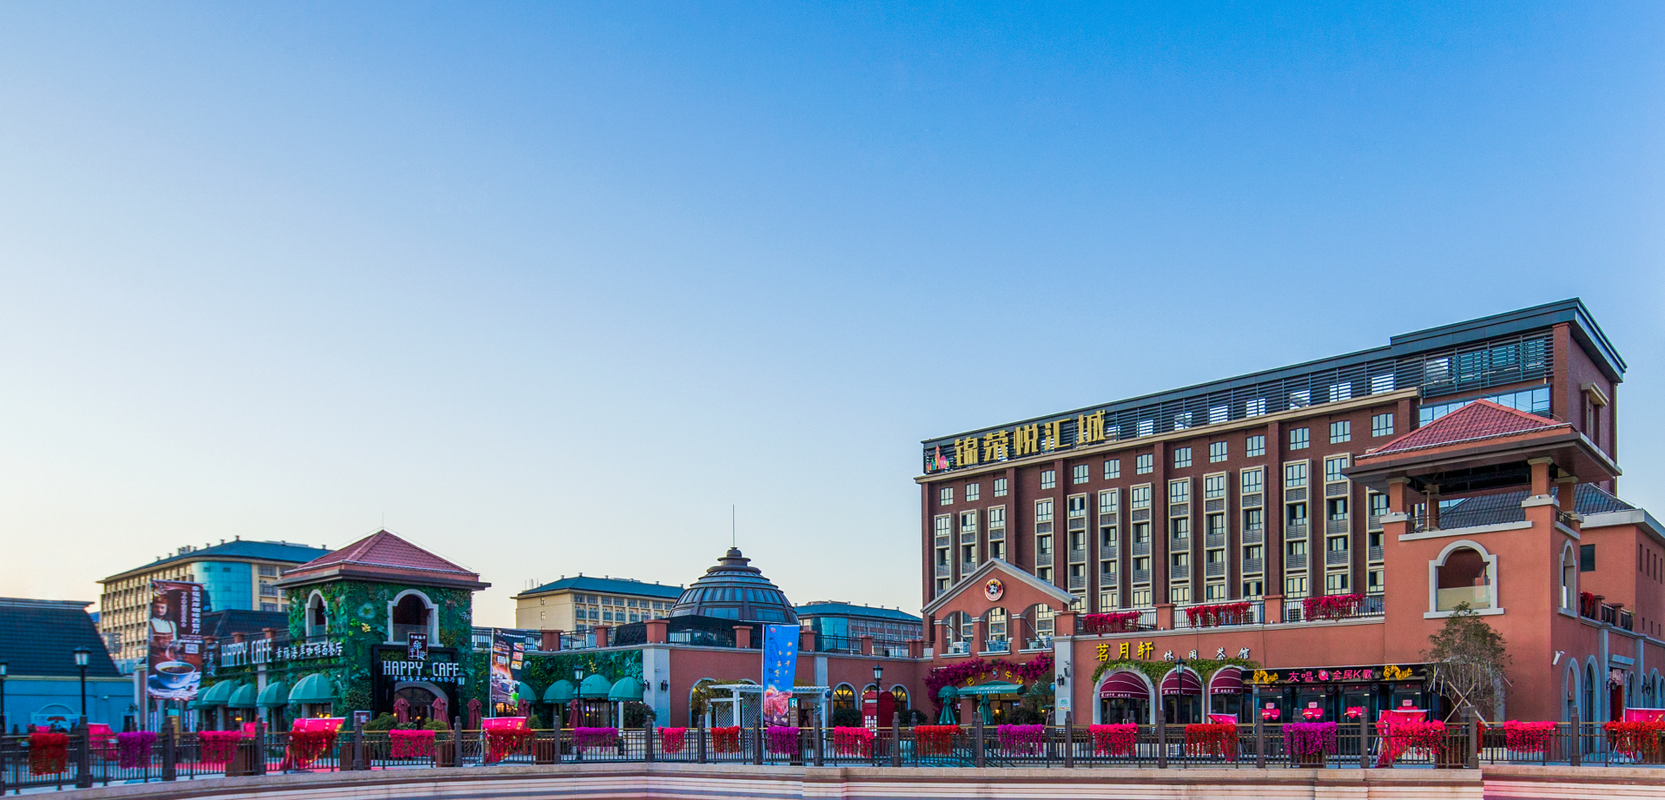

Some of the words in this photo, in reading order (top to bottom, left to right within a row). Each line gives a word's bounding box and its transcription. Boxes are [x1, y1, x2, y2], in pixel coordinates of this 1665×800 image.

[953, 408, 1107, 467] 锦荣悦汇城
[221, 641, 248, 668] HAPPY
[251, 638, 272, 664] CAFE
[1094, 640, 1155, 663] 茗月轩
[382, 660, 424, 676] HAPPY
[432, 662, 459, 677] CAFE
[1332, 668, 1373, 681] 全民K歌
